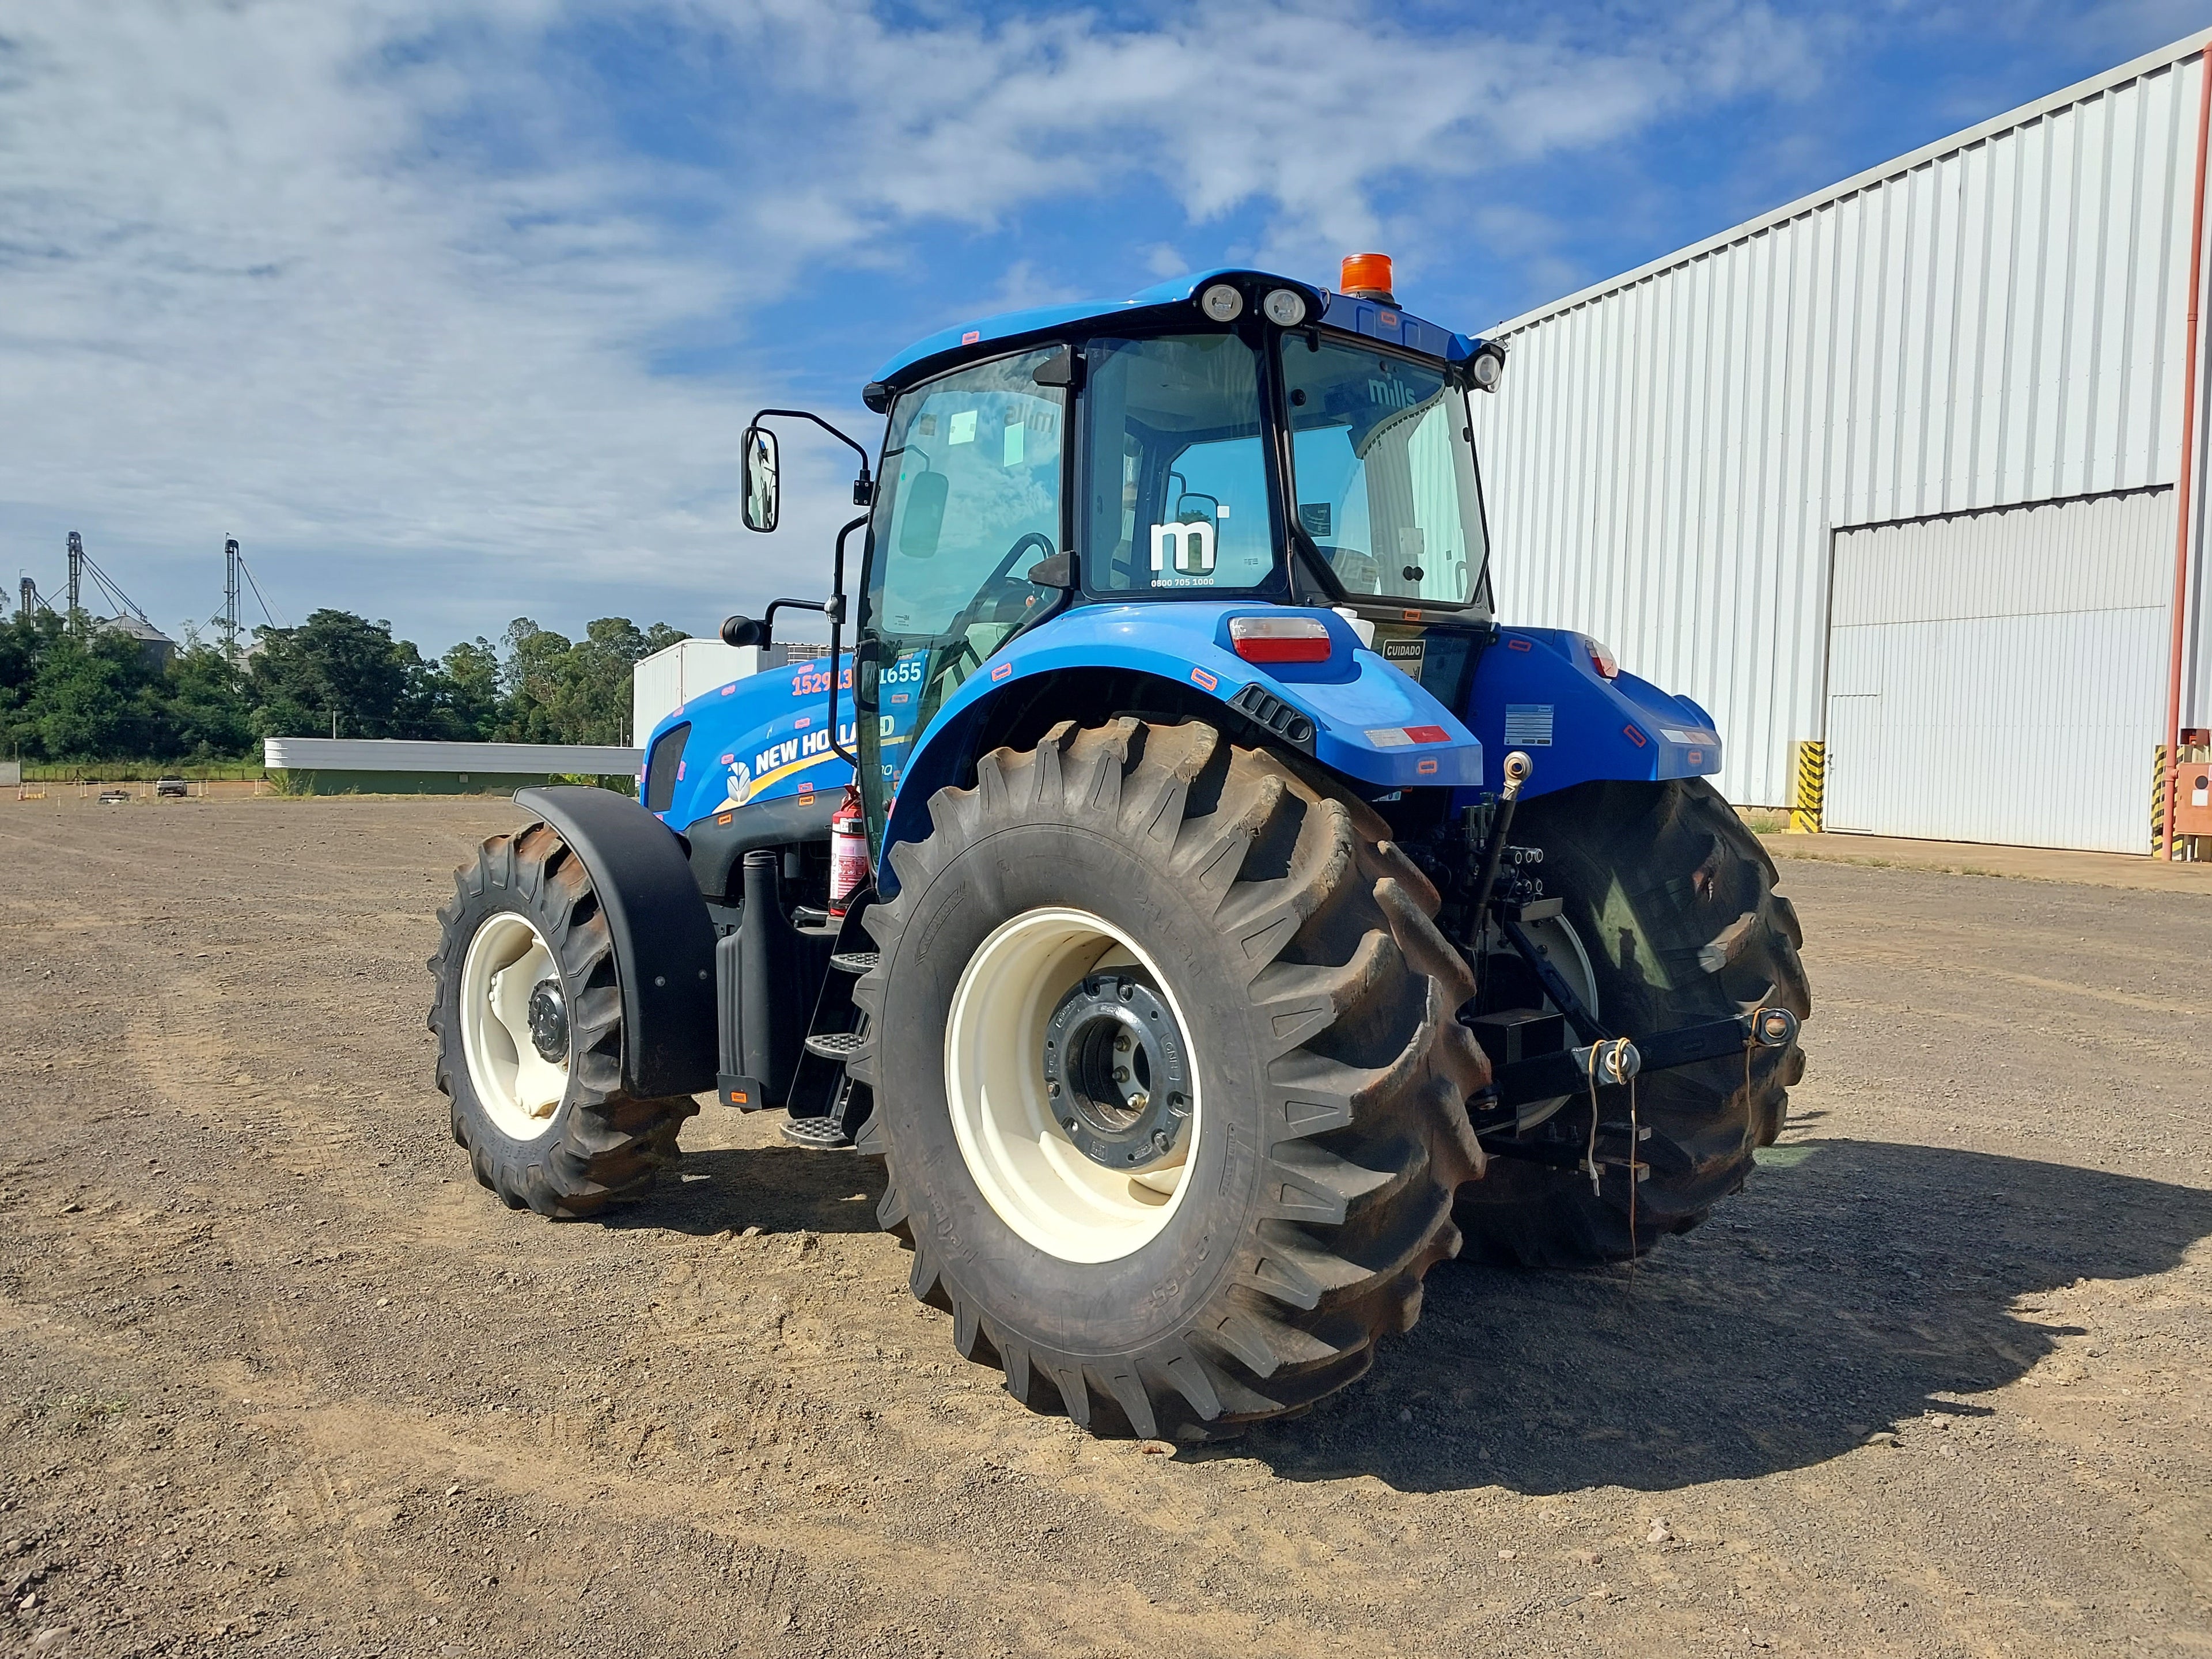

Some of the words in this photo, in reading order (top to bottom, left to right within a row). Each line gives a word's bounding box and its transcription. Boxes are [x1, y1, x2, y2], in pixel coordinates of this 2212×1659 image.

[1368, 372, 1416, 408] mills
[1387, 645, 1421, 656] CUIDADO
[756, 737, 798, 775] NEW
[802, 715, 895, 756] HOLD
